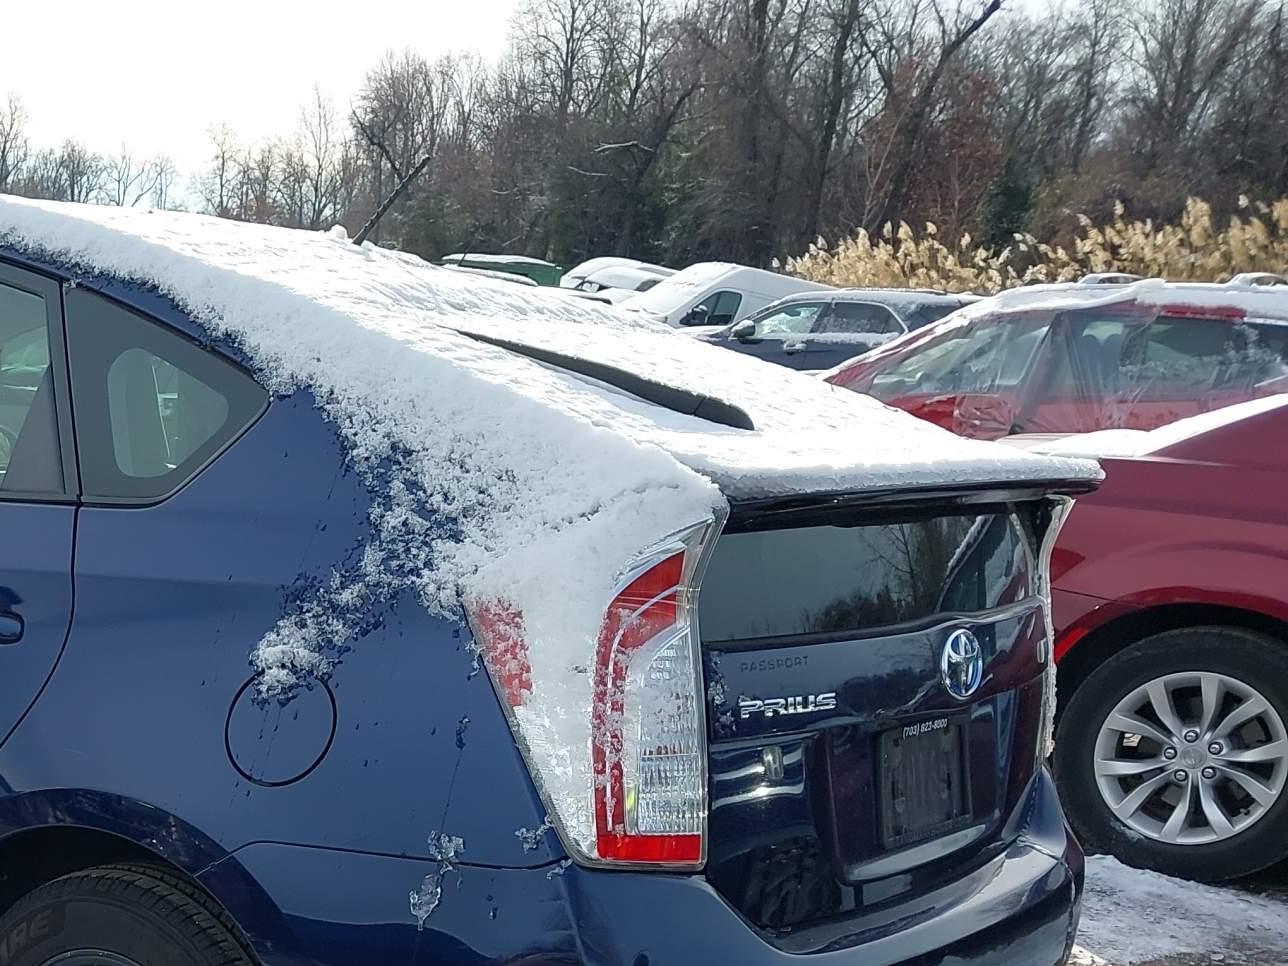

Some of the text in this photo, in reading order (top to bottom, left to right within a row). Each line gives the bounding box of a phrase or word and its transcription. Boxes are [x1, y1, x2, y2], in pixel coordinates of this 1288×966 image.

[740, 655, 809, 672] PASSPORT
[738, 692, 837, 719] PRIUS
[902, 722, 920, 740] (703)
